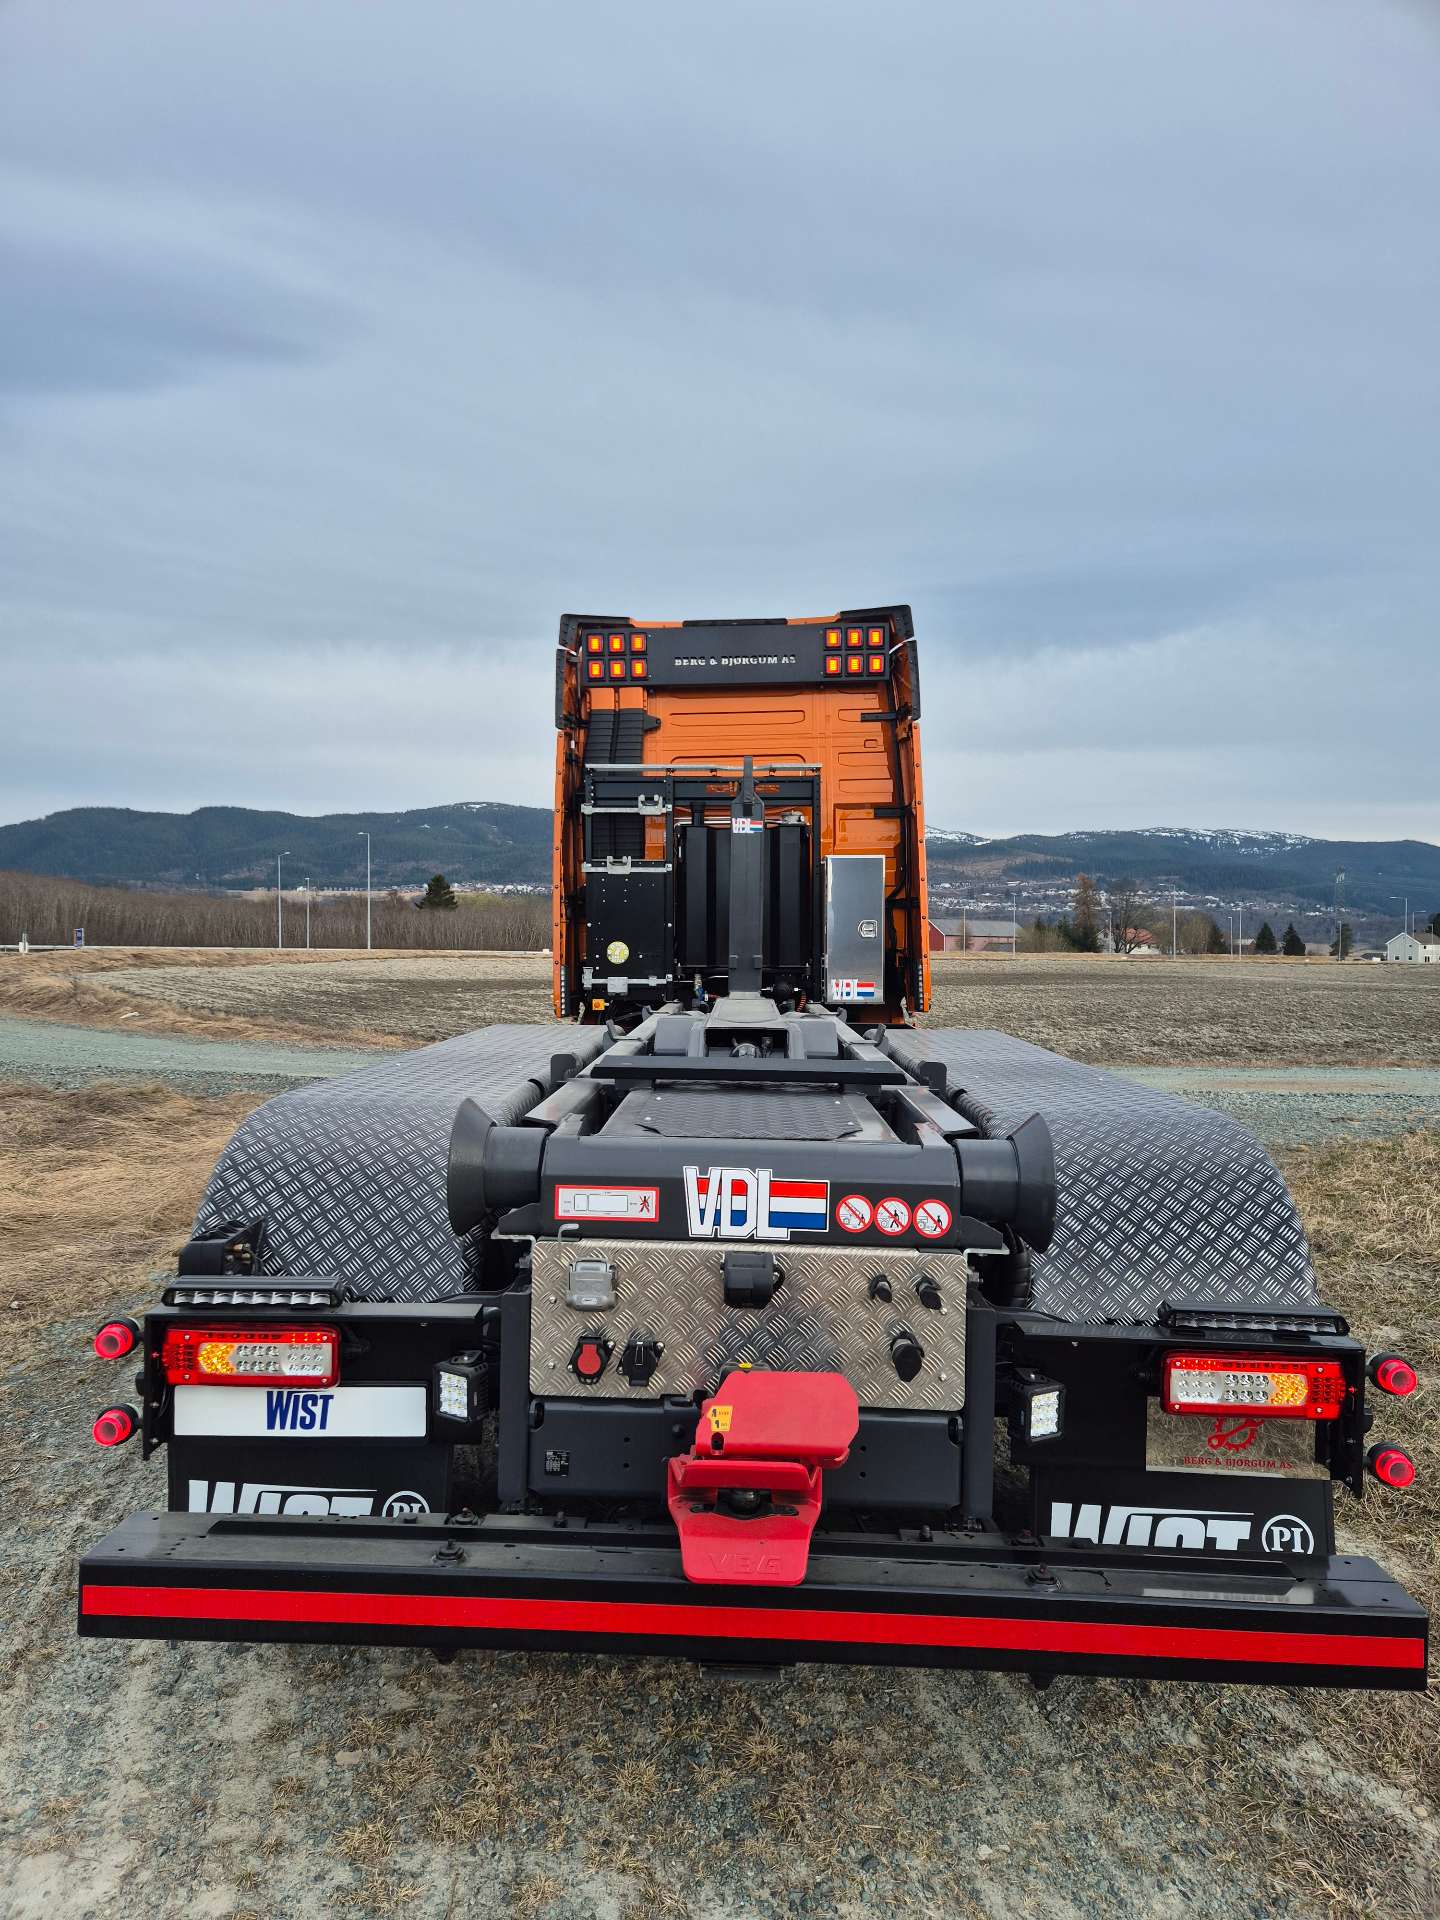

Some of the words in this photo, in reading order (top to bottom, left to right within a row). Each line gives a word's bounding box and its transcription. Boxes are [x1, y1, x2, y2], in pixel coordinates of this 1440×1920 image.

[674, 656, 706, 666] BERG
[709, 656, 718, 666] &
[781, 654, 796, 664] AS
[684, 1166, 789, 1239] VDL
[266, 1390, 335, 1430] WIST
[1184, 1456, 1212, 1466] BERG
[1215, 1458, 1222, 1467] &
[1279, 1461, 1292, 1470] AS
[709, 1553, 781, 1575] VBG
